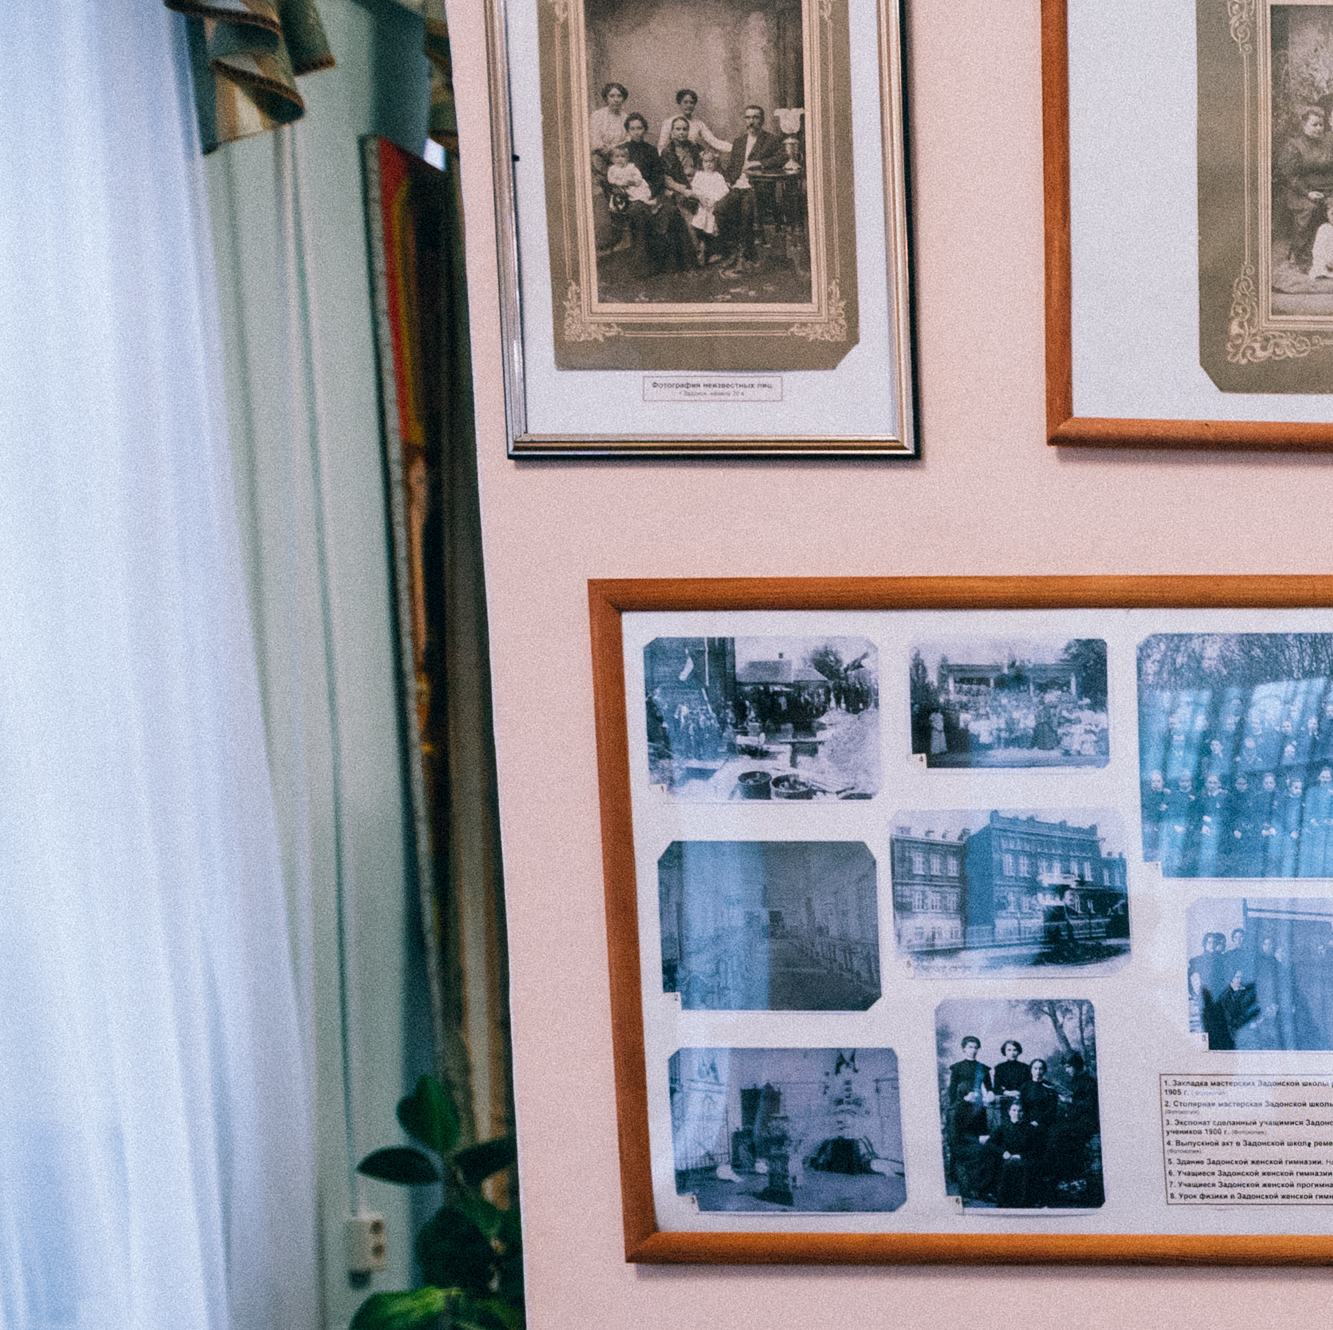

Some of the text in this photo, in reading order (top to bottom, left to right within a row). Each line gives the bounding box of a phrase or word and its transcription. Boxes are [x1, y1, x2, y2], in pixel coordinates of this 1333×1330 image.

[1172, 1080, 1209, 1088] Закладка
[1258, 1079, 1300, 1088] Задонской
[1164, 1100, 1172, 1108] 2.
[1173, 1100, 1216, 1109] Столярная
[1265, 1100, 1307, 1109] Задонской
[1212, 1119, 1257, 1128] сделанный
[1259, 1120, 1304, 1128] учащимися
[1205, 1128, 1223, 1136] 1900
[1175, 1139, 1219, 1148] Выпускной
[1243, 1139, 1285, 1148] Задонской
[1176, 1158, 1205, 1167] Здание
[1206, 1158, 1248, 1167] Задонской
[1177, 1170, 1216, 1178] Учащиеся
[1217, 1169, 1259, 1178] Задонской
[1169, 1181, 1176, 1189] 7.
[1178, 1181, 1216, 1190] Учащиеся
[1217, 1181, 1259, 1190] Задонской
[1261, 1181, 1295, 1189] женской
[1170, 1192, 1176, 1200] 8.
[1178, 1193, 1197, 1201] Урок
[1199, 1193, 1228, 1201] физики
[1237, 1192, 1279, 1201] Задонской
